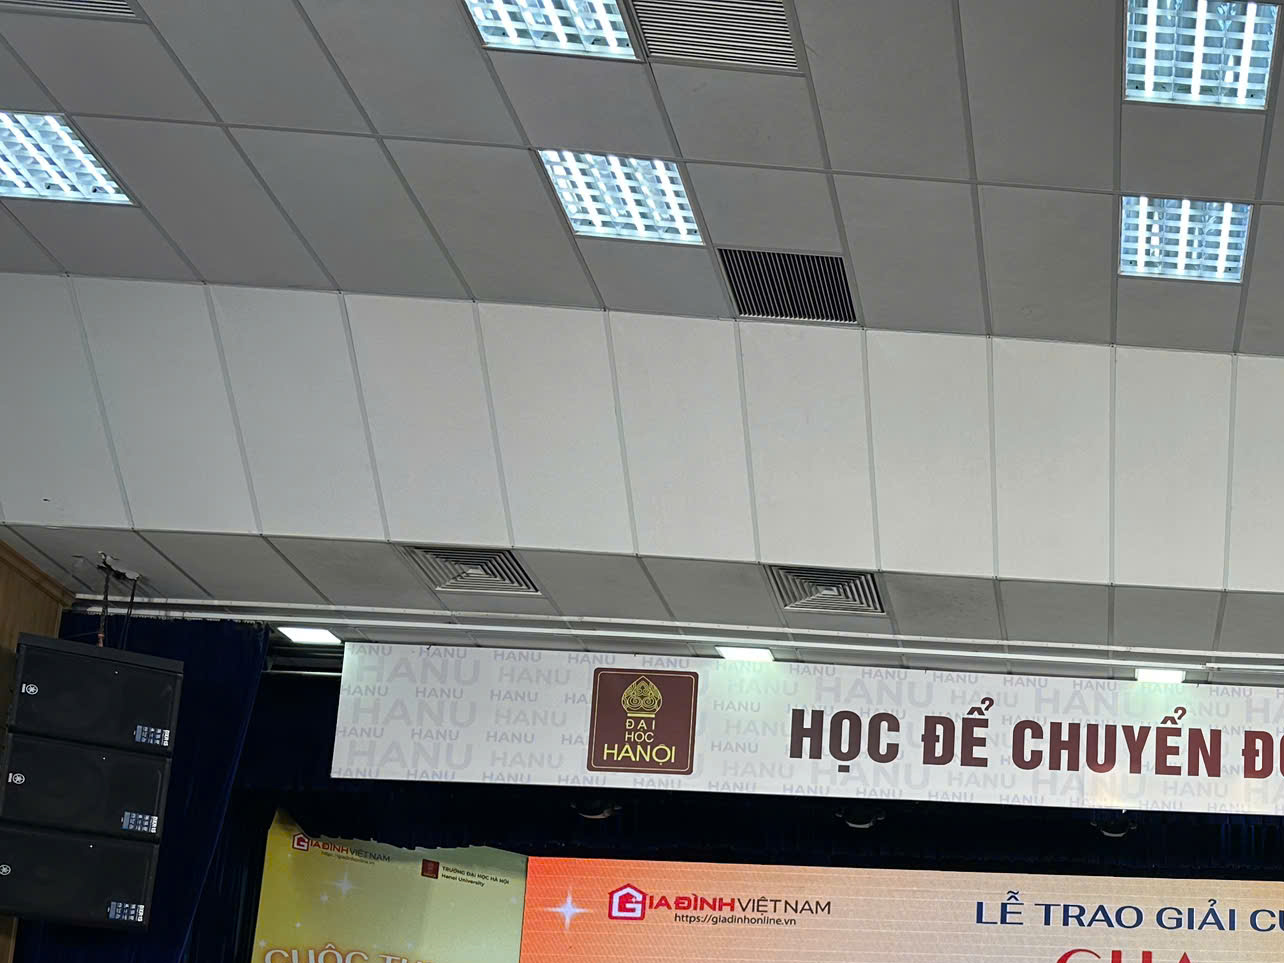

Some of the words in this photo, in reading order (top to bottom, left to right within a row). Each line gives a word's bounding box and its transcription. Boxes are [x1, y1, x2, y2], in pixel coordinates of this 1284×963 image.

[624, 731, 655, 744] HỌC
[789, 708, 900, 773] HỌC
[921, 696, 995, 768] ĐỂ
[1012, 706, 1222, 778] CHUYỂN
[674, 913, 797, 927] https://giadinhonline.vn
[974, 890, 1024, 925] LỄ
[1034, 903, 1144, 930] TRAO
[1156, 898, 1236, 932] GIẢI
